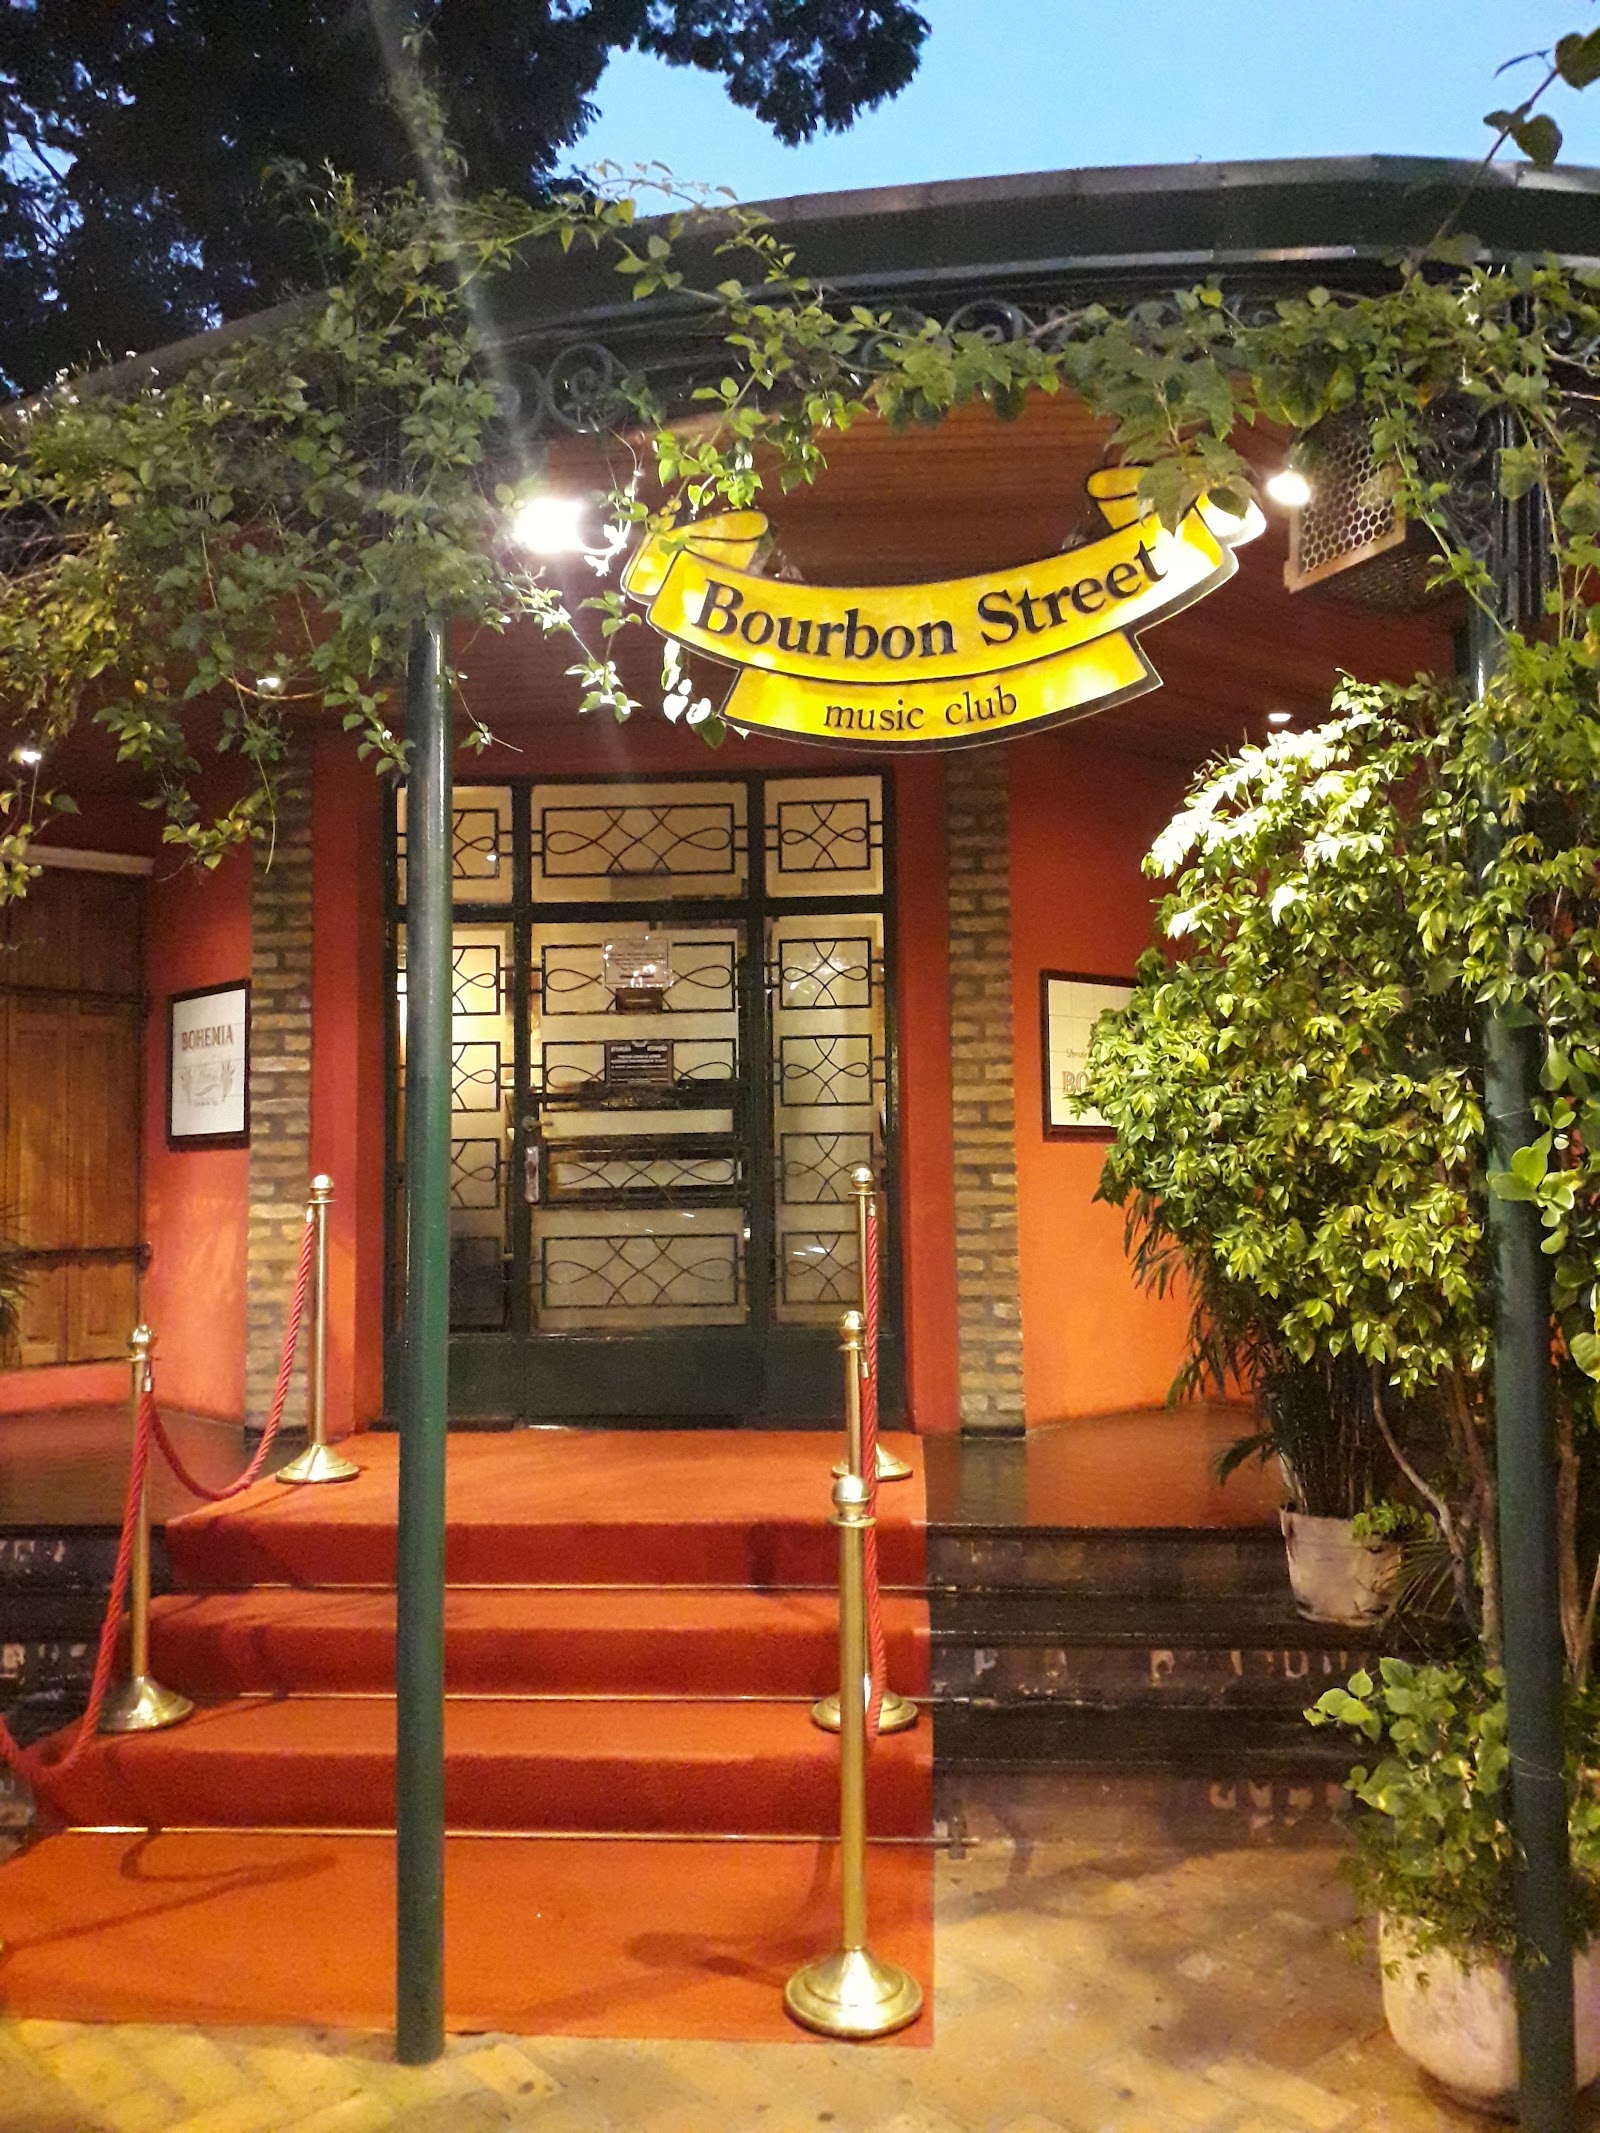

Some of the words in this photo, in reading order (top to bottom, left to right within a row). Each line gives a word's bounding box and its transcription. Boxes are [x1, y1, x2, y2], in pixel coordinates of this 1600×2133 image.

[691, 578, 956, 660] Bourbon
[977, 540, 1168, 646] Street
[824, 698, 925, 732] music
[945, 686, 1018, 726] club
[181, 1024, 234, 1051] BOHEMIA
